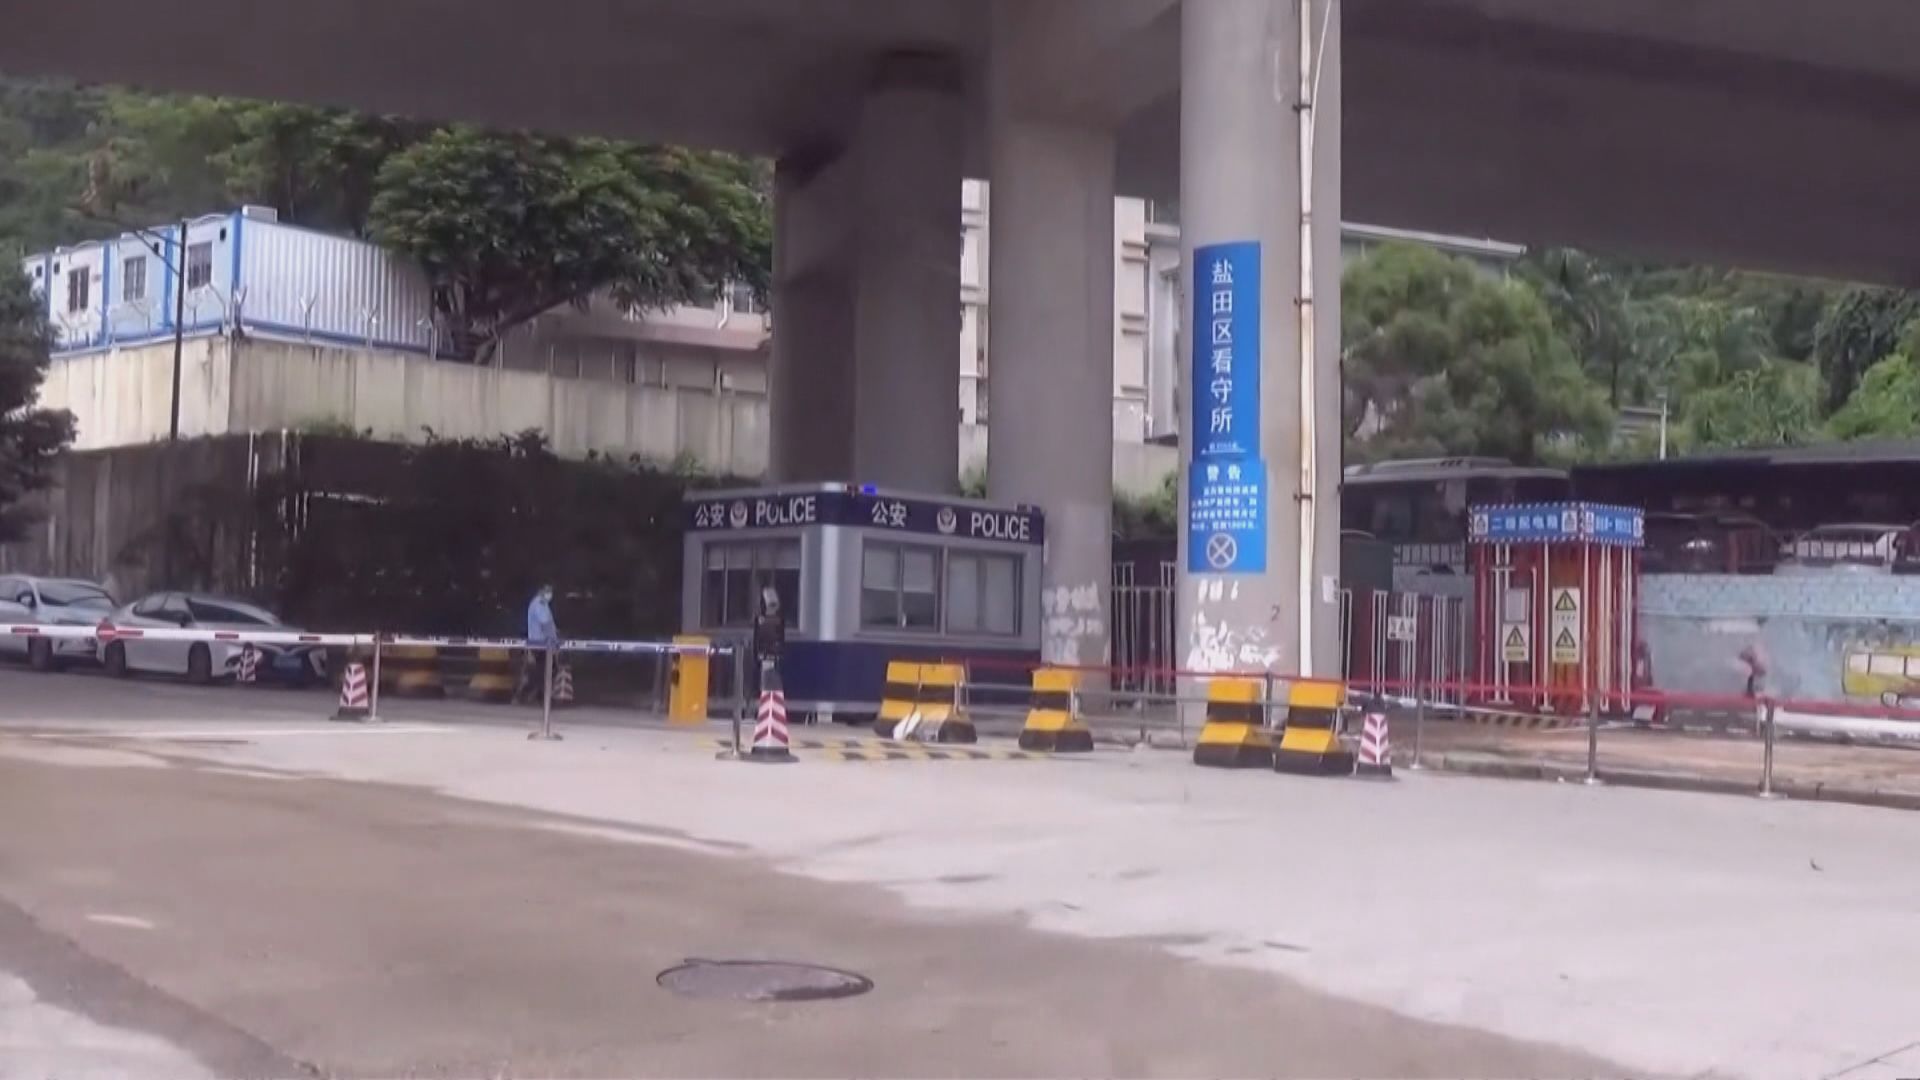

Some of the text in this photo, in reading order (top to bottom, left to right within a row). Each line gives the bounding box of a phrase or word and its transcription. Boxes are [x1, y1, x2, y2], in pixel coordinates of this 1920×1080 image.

[1210, 258, 1234, 433] 盐田区看守所
[695, 495, 817, 528] 公安 POLICE
[871, 500, 1030, 541] 公安 POLICE
